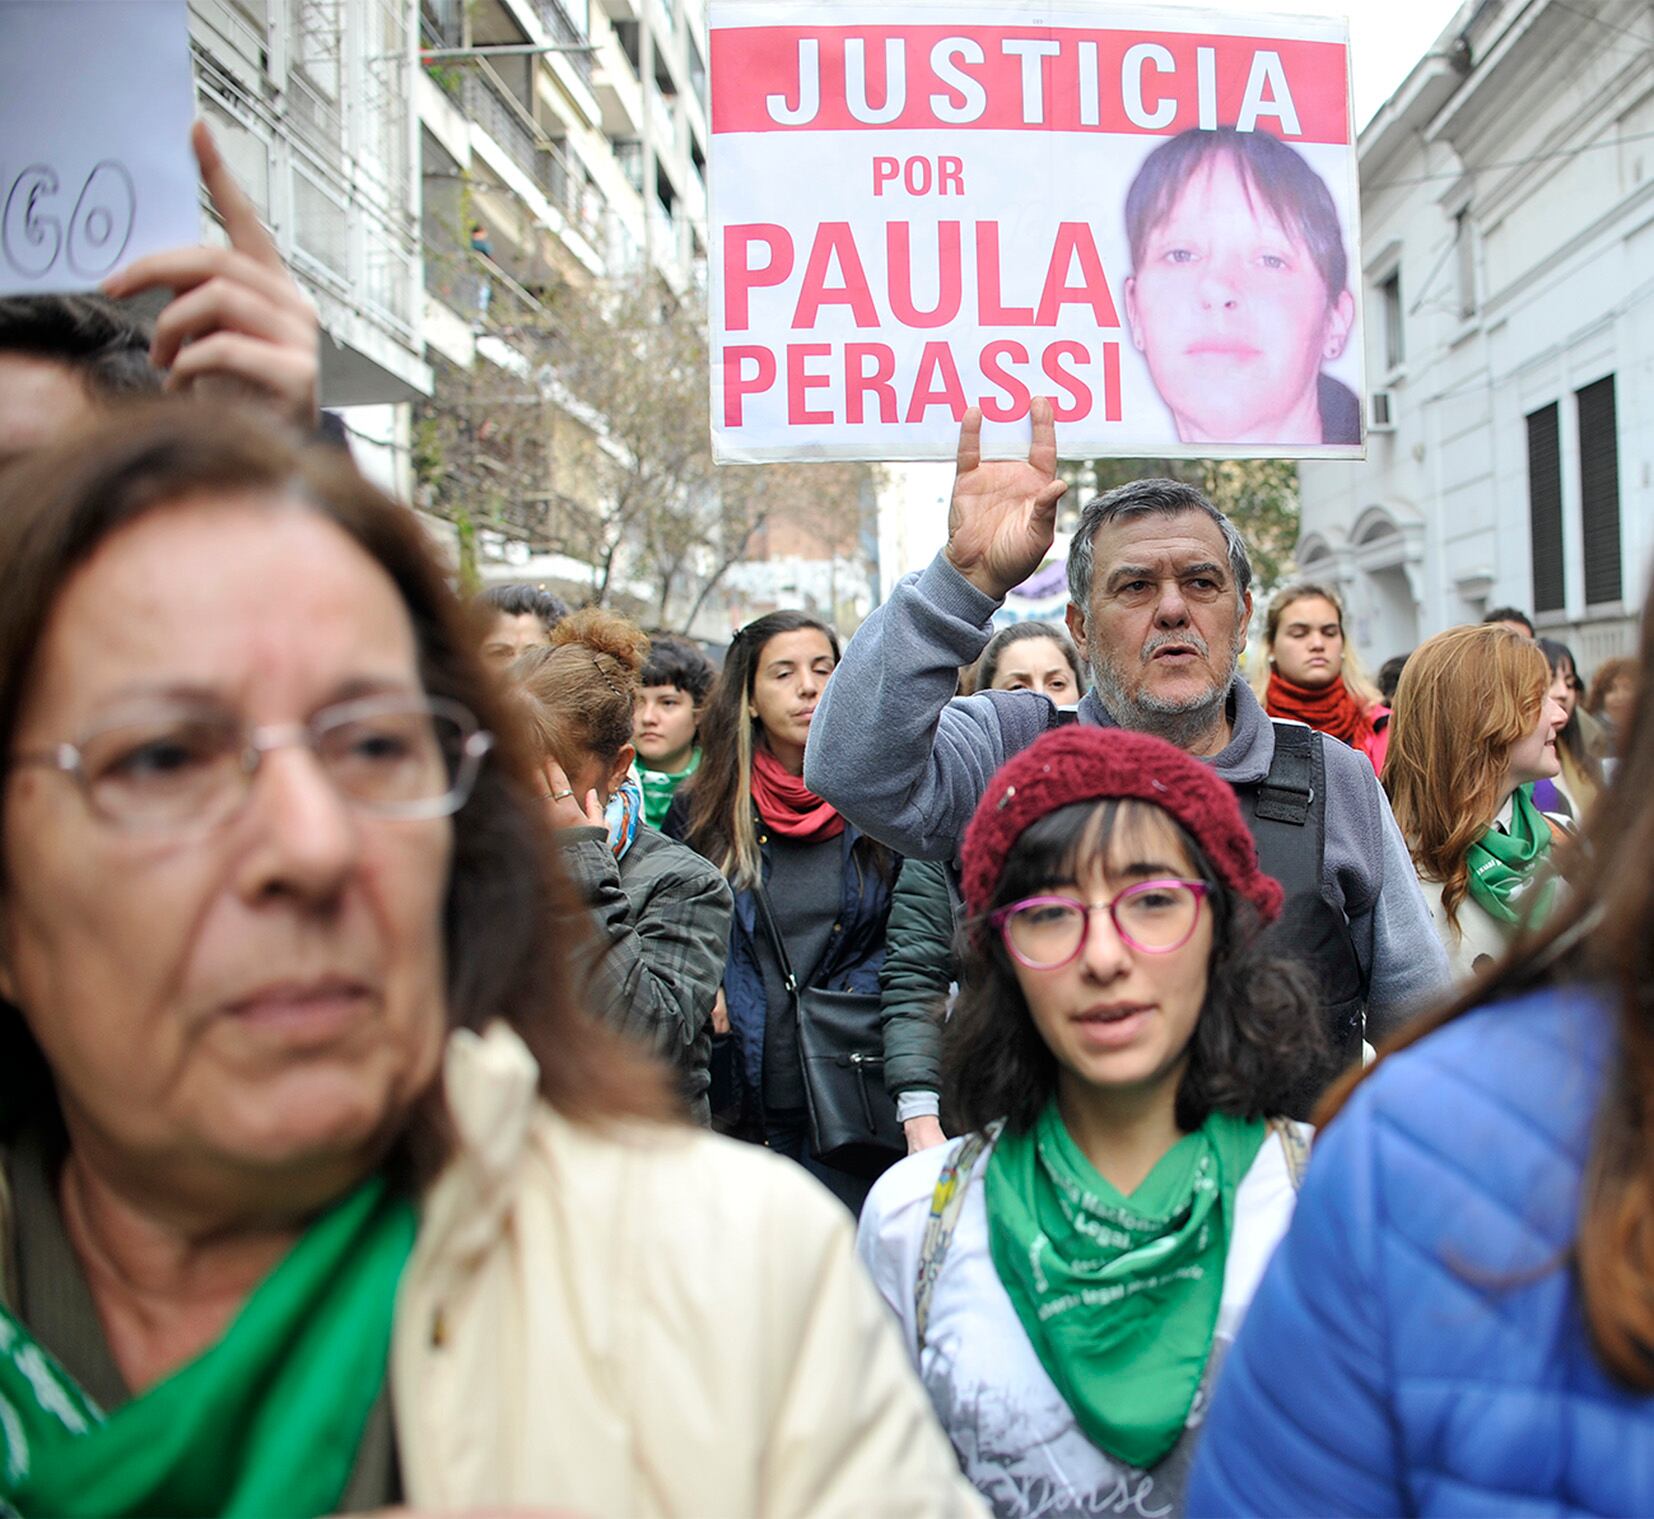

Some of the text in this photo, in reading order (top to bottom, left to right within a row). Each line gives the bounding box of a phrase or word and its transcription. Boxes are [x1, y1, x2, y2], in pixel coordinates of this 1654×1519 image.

[765, 37, 1302, 135] JUSTICIA
[873, 156, 966, 197] POR
[723, 220, 1120, 331] PAULA
[723, 340, 1122, 427] PERASSI
